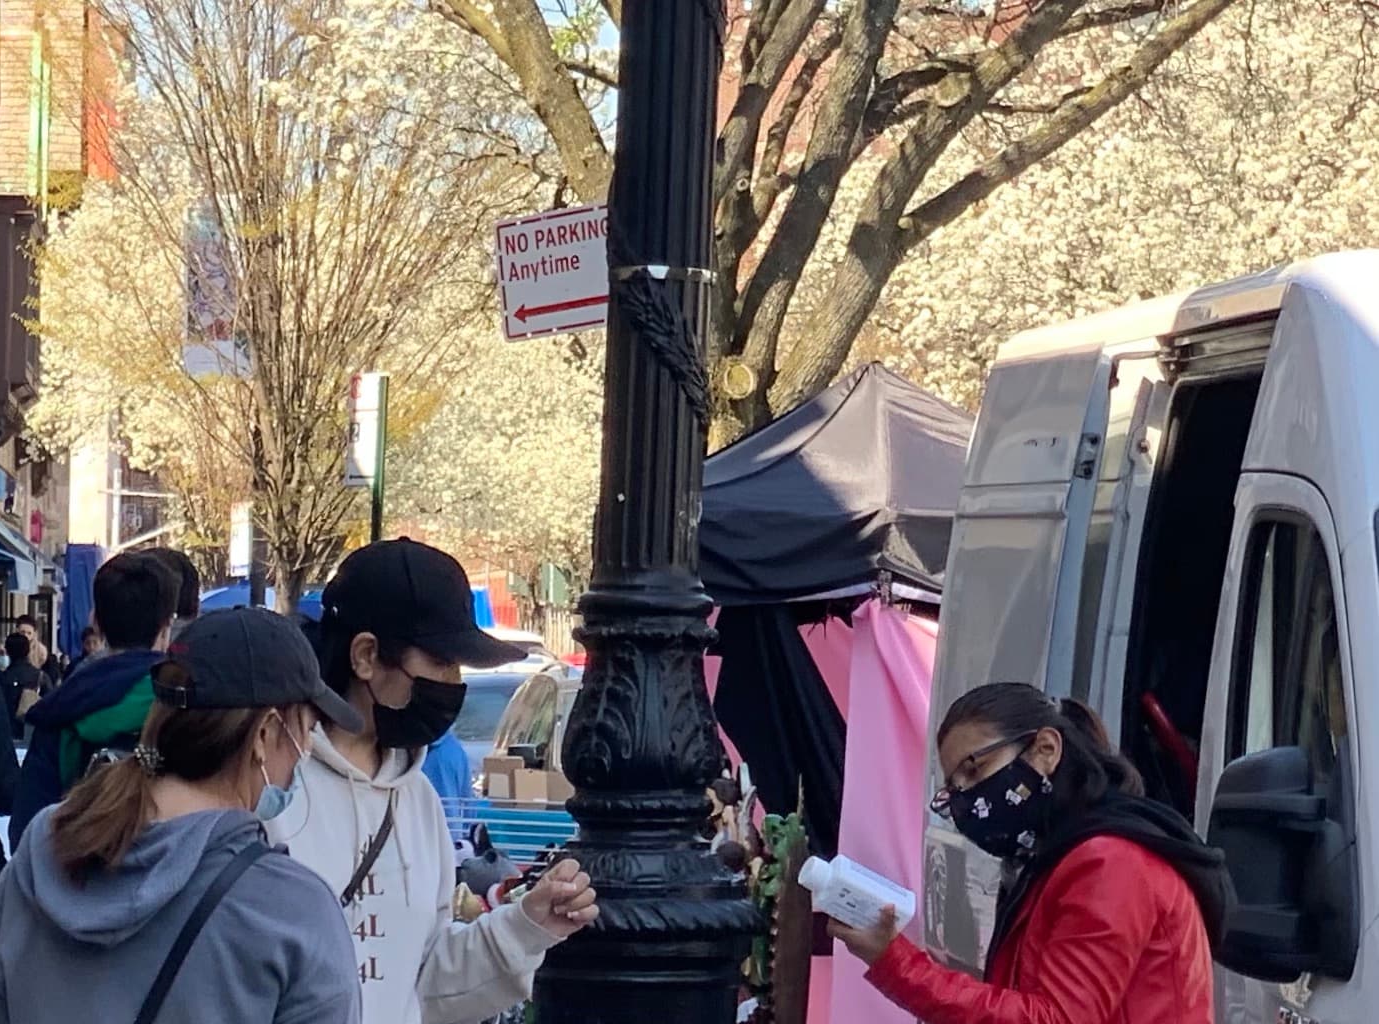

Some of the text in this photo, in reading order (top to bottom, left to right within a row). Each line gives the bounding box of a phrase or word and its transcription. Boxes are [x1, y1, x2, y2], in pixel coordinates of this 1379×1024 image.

[505, 218, 610, 256] NO PARKING
[509, 253, 581, 282] Anytime
